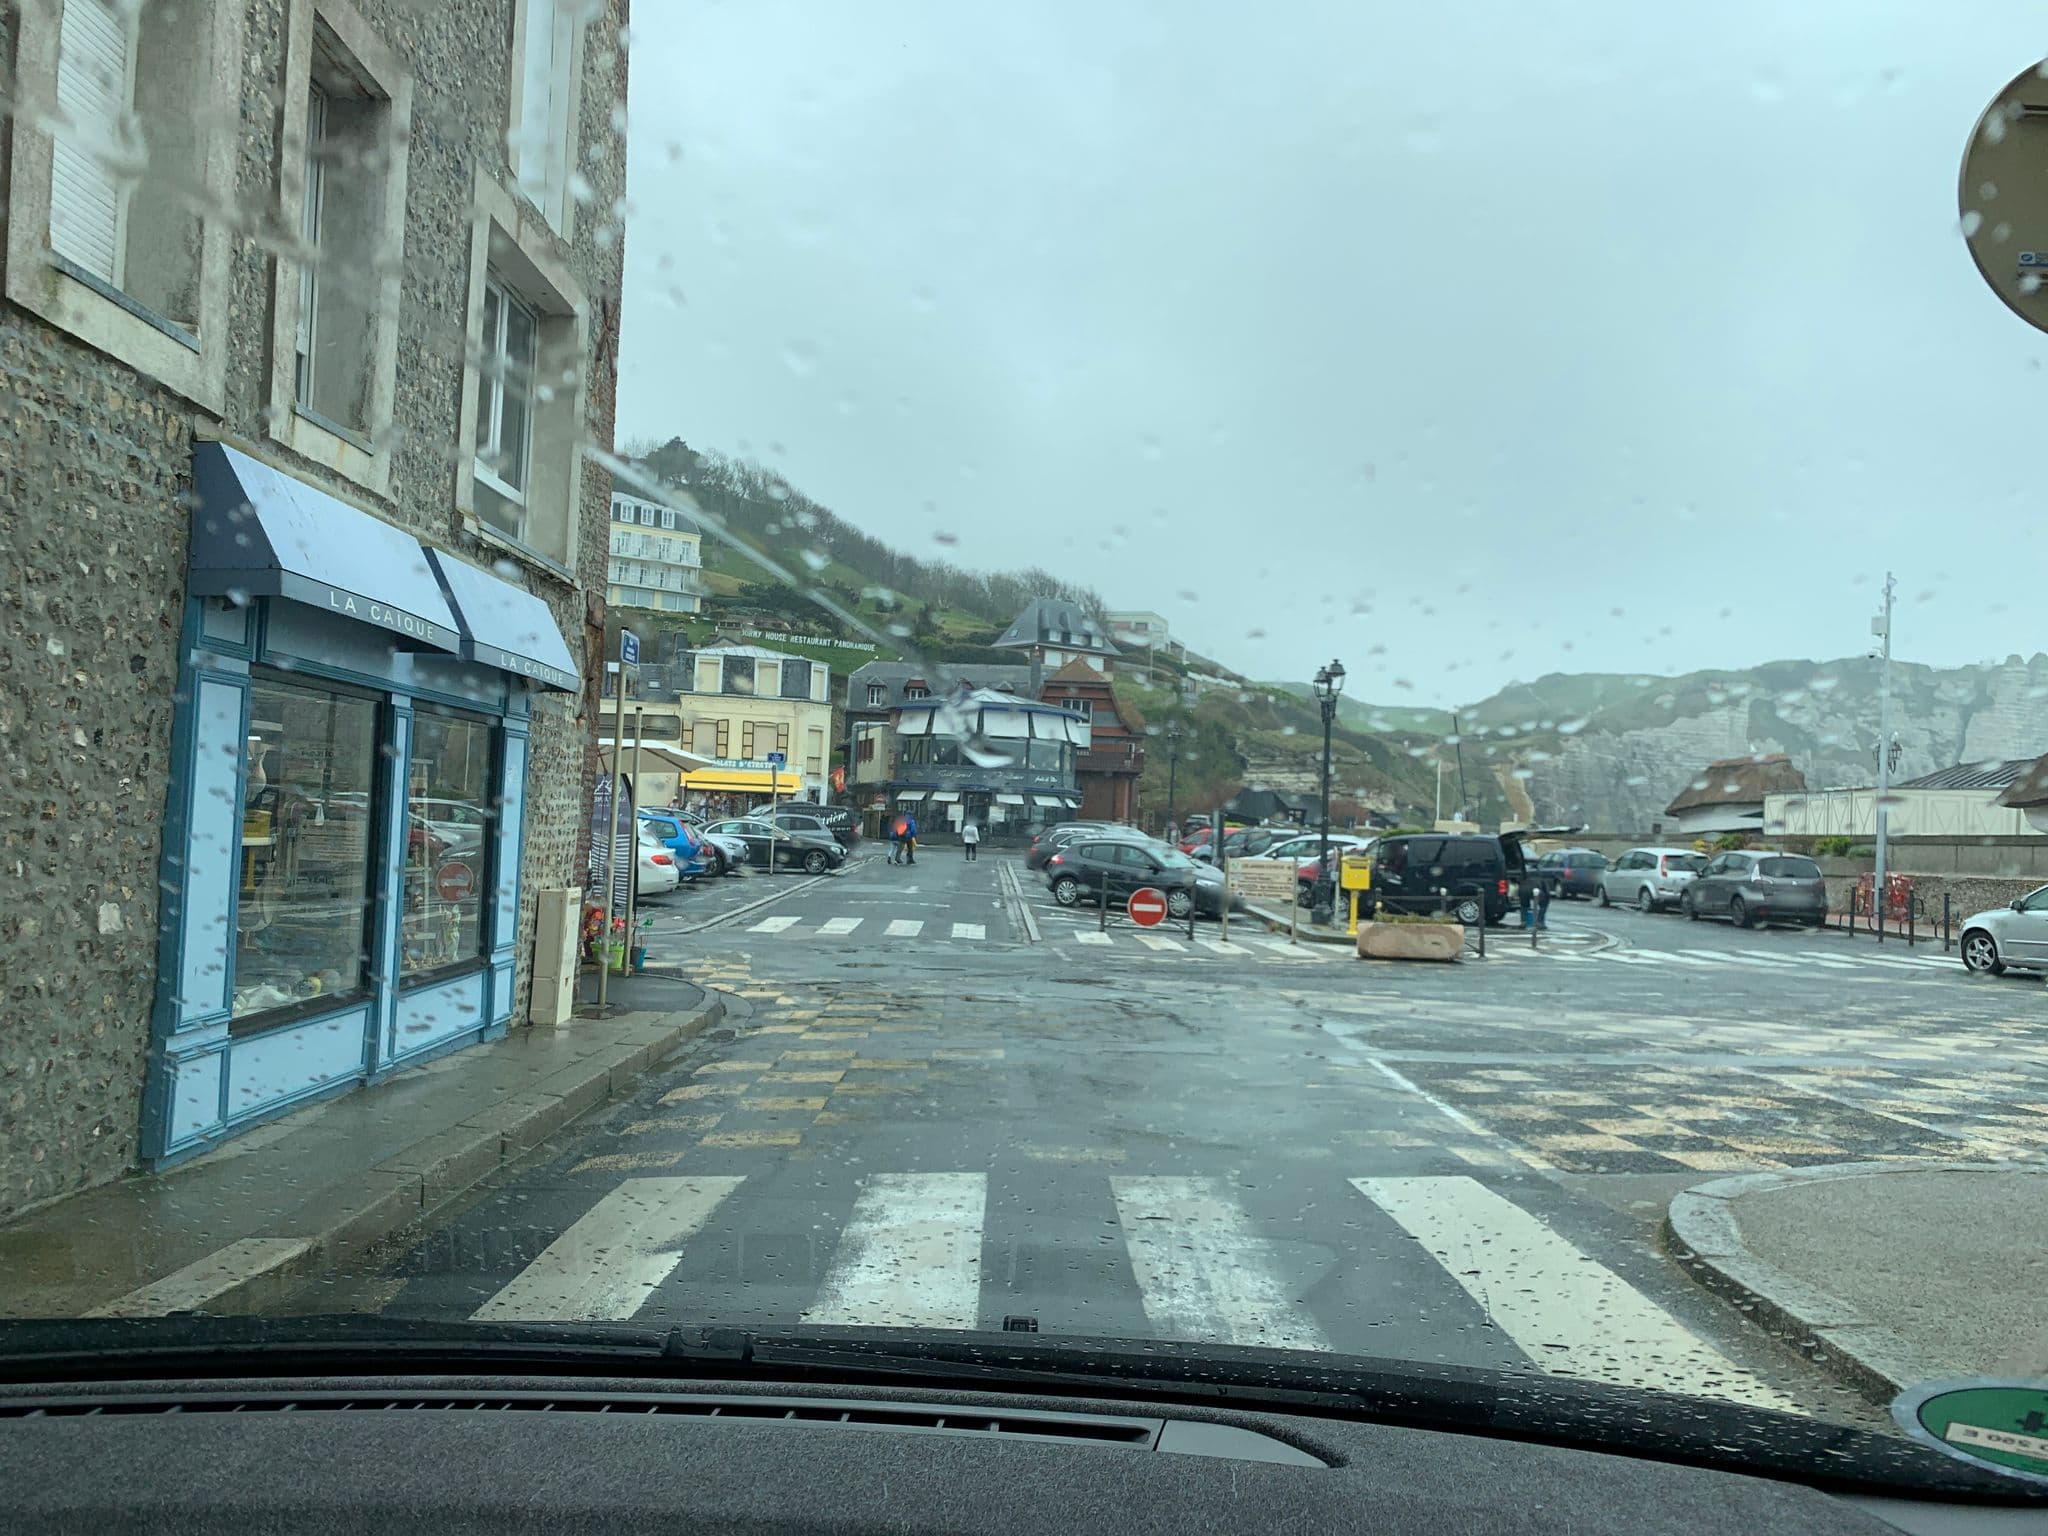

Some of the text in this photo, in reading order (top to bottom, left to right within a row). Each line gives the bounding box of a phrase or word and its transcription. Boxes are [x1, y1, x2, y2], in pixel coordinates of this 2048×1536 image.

[330, 590, 434, 640] LA CAIQUE
[765, 631, 788, 642] HOUSE
[790, 635, 831, 647] RESTAURANT
[834, 639, 877, 652] PANORAMIQUE
[501, 653, 564, 684] LA CAIQUE
